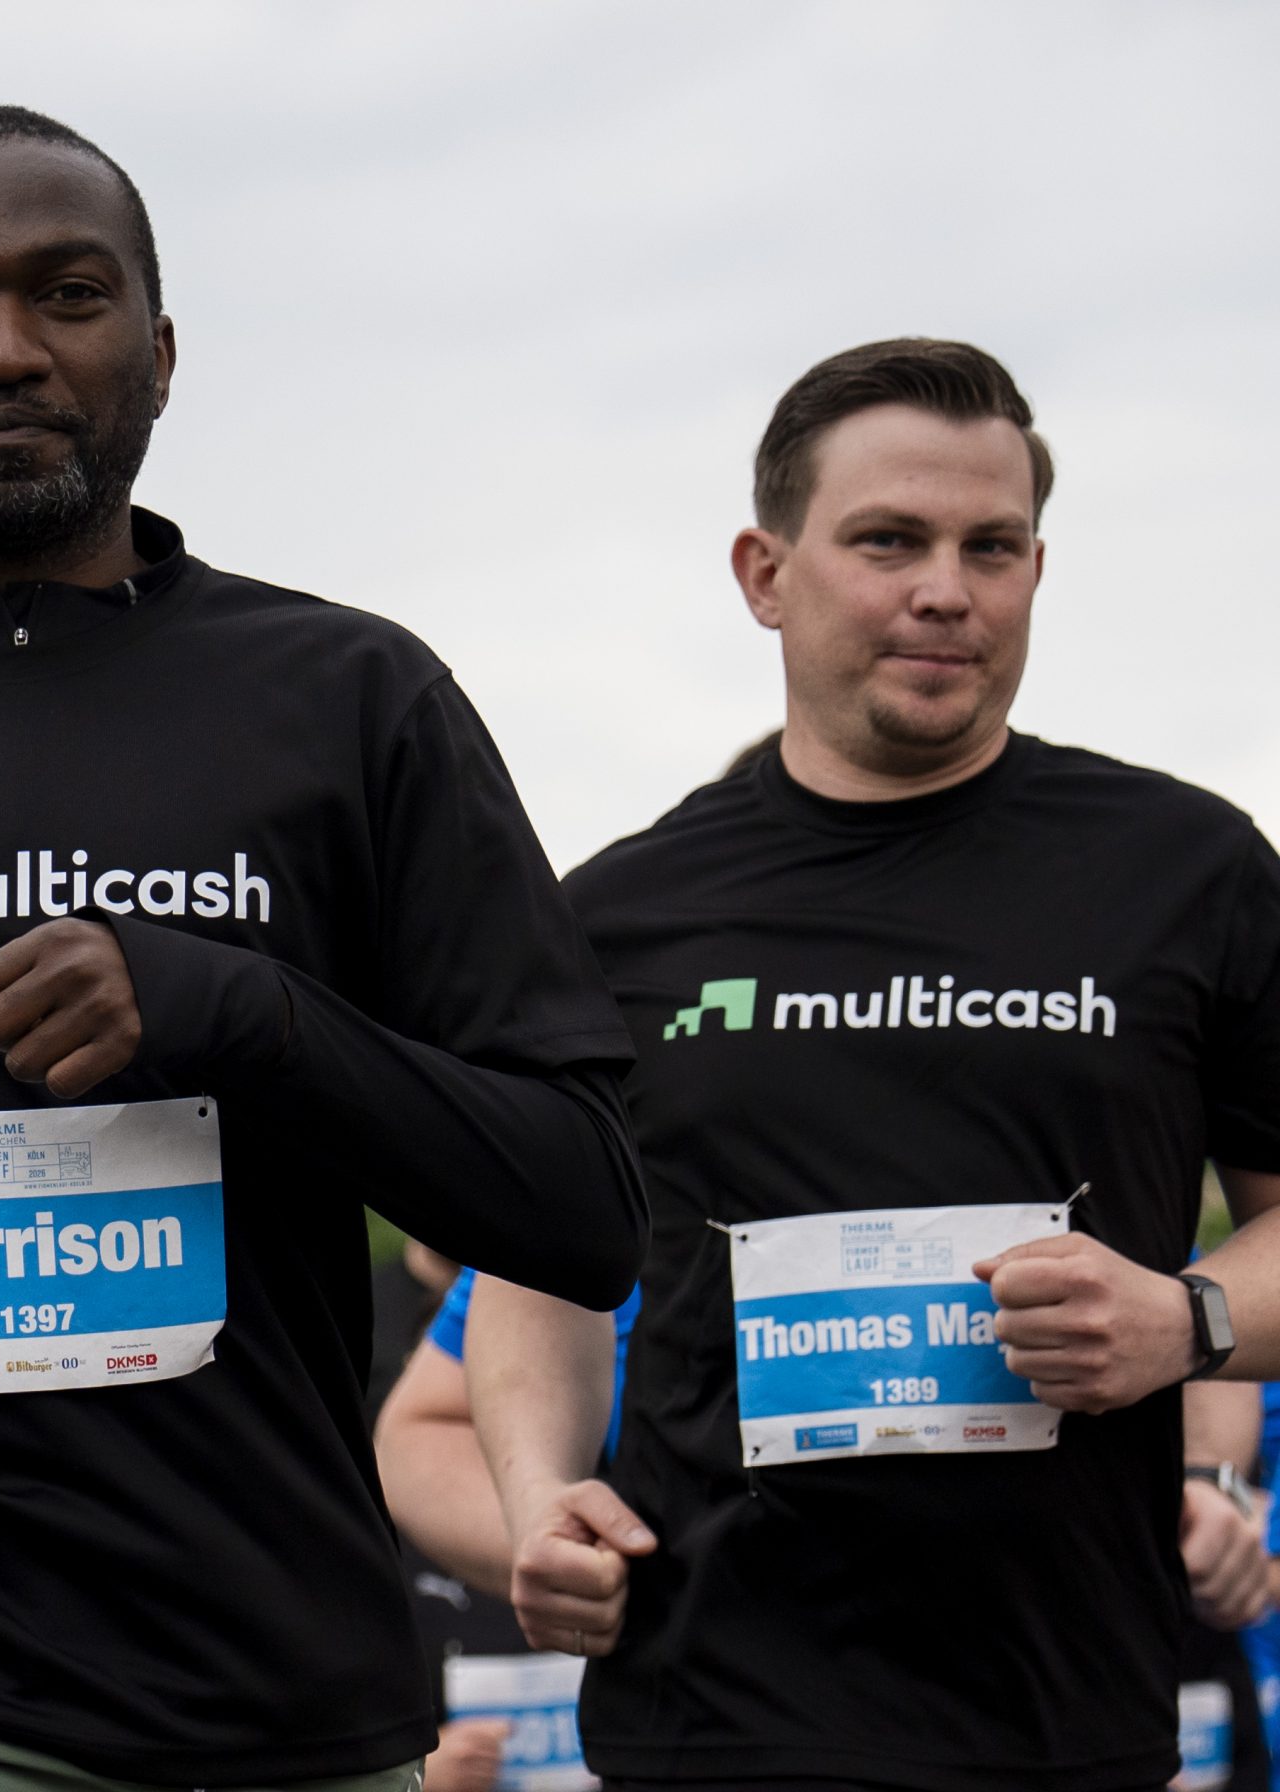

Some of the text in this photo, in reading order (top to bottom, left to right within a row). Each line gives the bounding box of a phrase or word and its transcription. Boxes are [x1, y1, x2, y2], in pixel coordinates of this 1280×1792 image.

[773, 975, 1117, 1037] multicash
[27, 1150, 46, 1160] KÖLN
[0, 1303, 75, 1334] 1397
[738, 1303, 1009, 1361] Thomas Ma
[106, 1355, 145, 1369] DKMS
[870, 1377, 939, 1405] 1389
